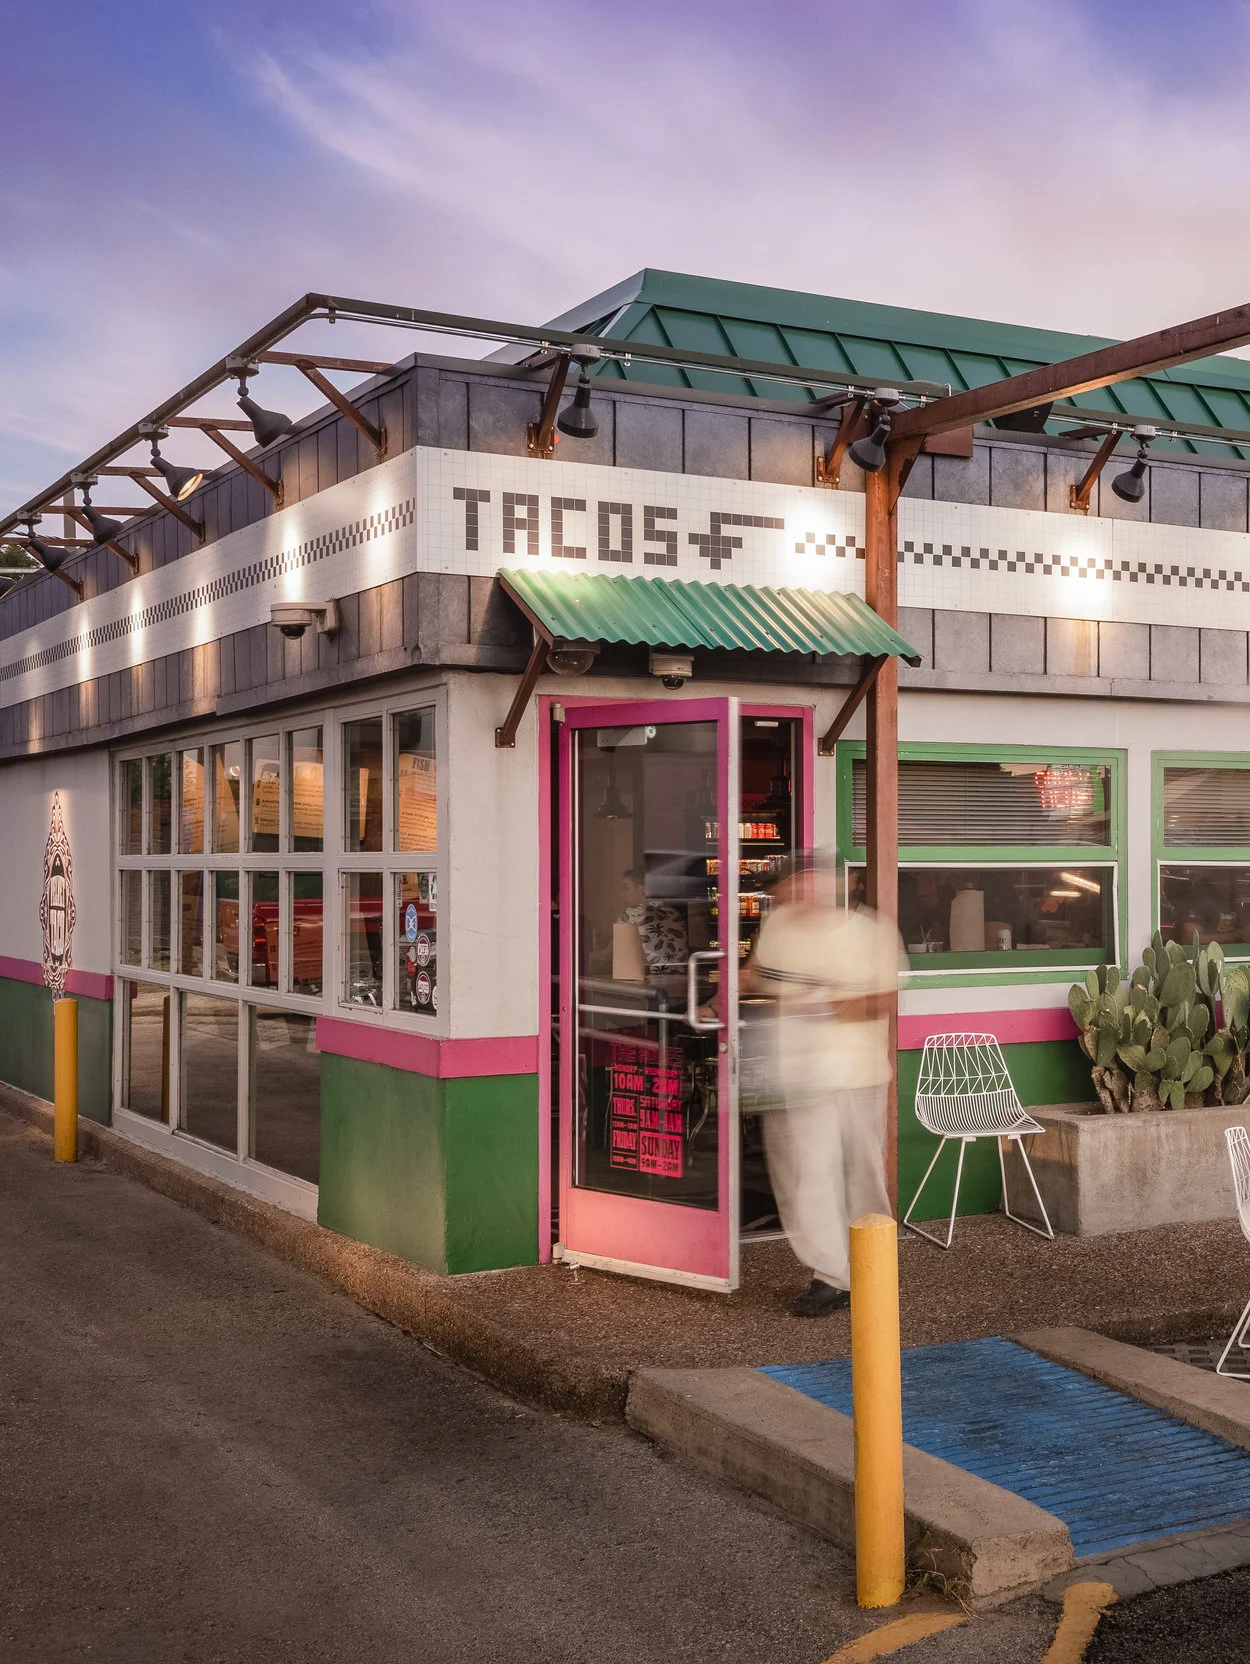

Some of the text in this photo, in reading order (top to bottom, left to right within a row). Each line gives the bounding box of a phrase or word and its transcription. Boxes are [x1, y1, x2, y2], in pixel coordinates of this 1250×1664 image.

[453, 487, 677, 566] TACOS
[613, 1073, 644, 1092] 10AM
[612, 1130, 638, 1151] FRIDAY
[641, 1135, 680, 1161] SUNDAY
